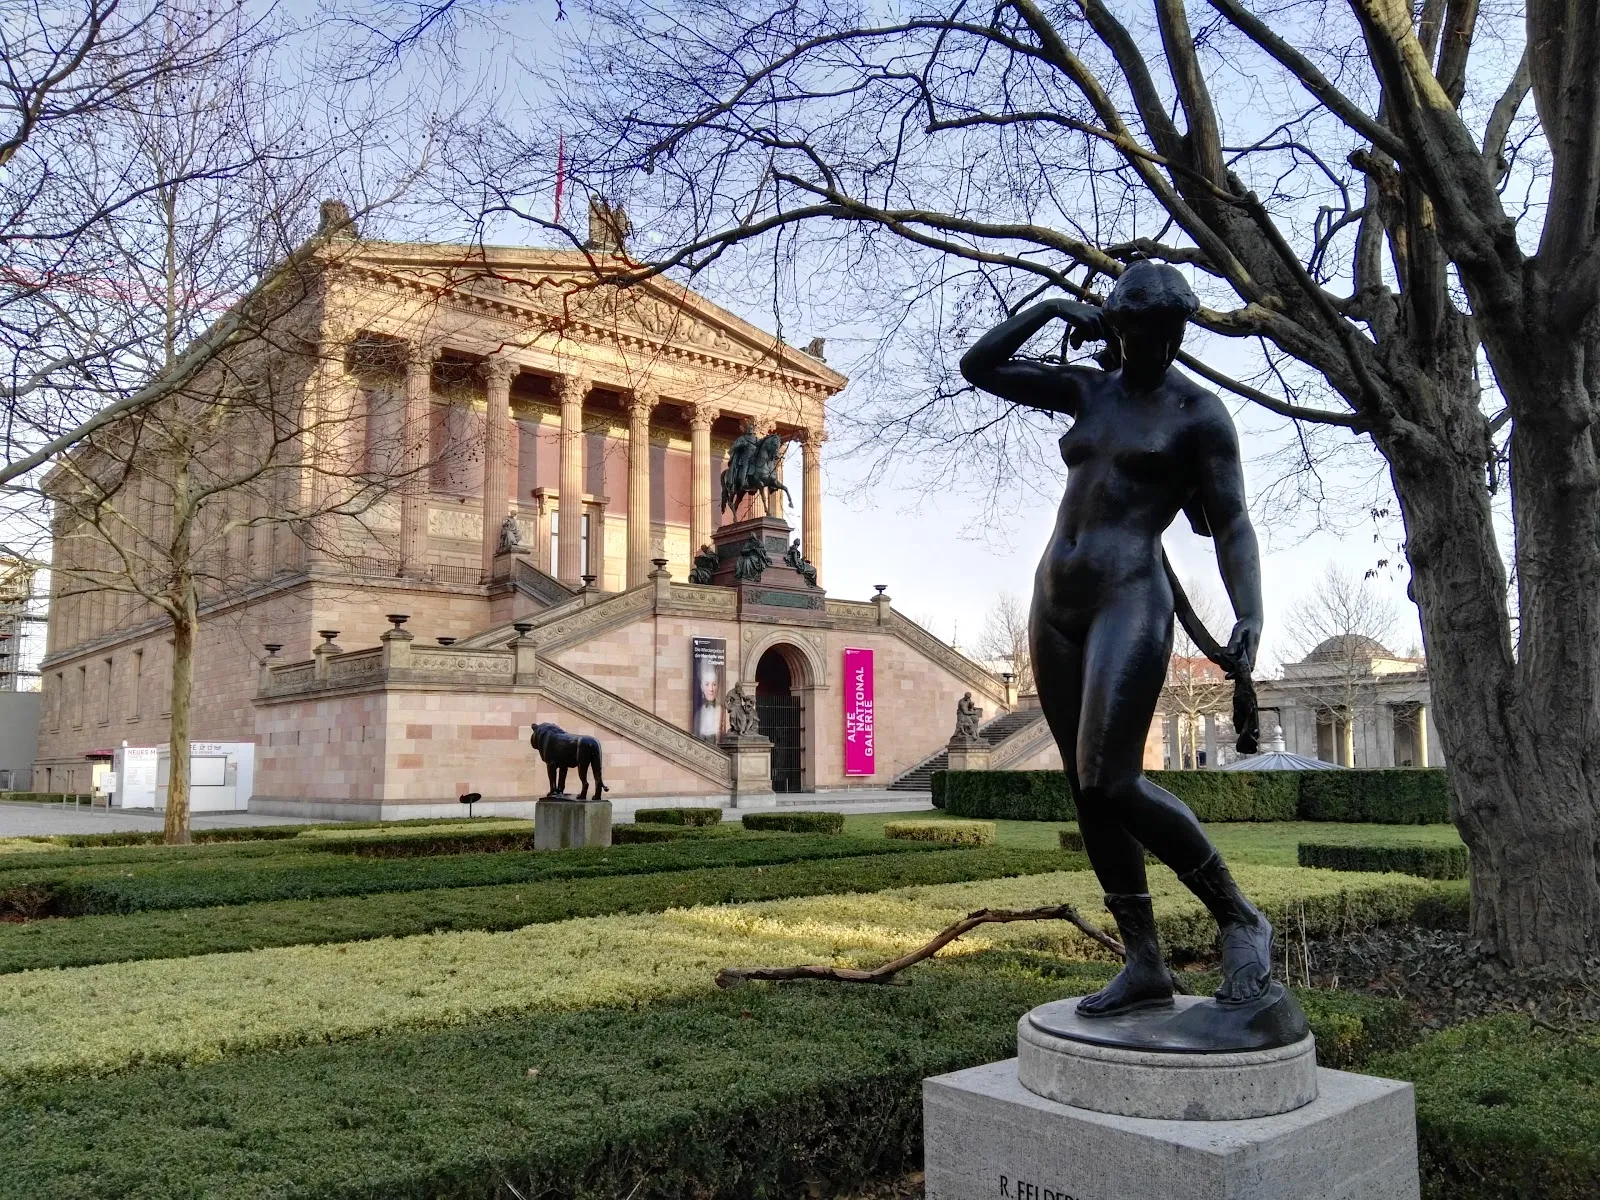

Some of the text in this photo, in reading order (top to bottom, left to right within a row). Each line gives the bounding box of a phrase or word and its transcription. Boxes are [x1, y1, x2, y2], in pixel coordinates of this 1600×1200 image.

[847, 712, 856, 743] ALTE
[856, 667, 864, 732] NATIONAL
[865, 700, 873, 757] GALERIE
